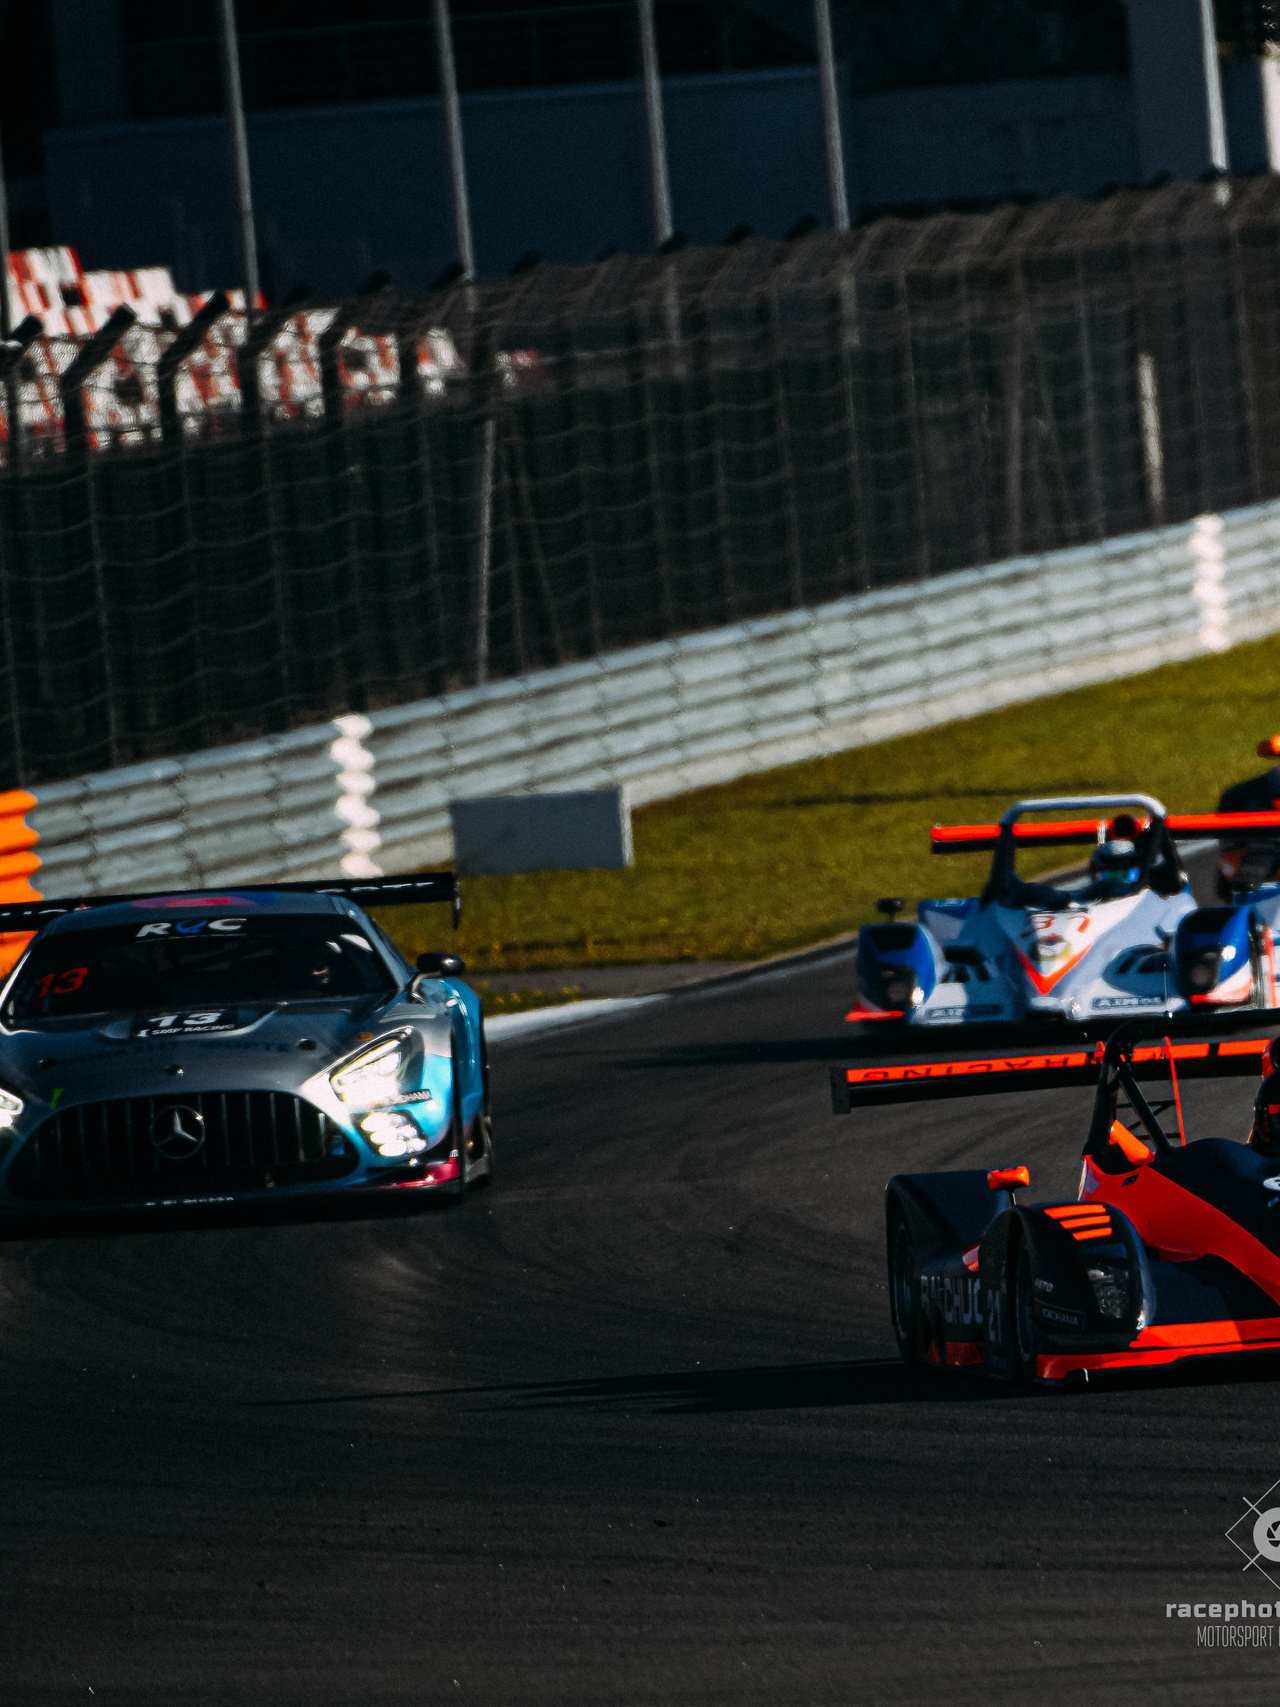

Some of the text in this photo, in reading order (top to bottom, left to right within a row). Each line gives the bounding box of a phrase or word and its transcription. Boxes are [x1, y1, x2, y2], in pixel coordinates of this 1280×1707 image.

[36, 966, 89, 998] 13
[148, 1011, 222, 1028] 13
[150, 1023, 235, 1036] SMP RACING
